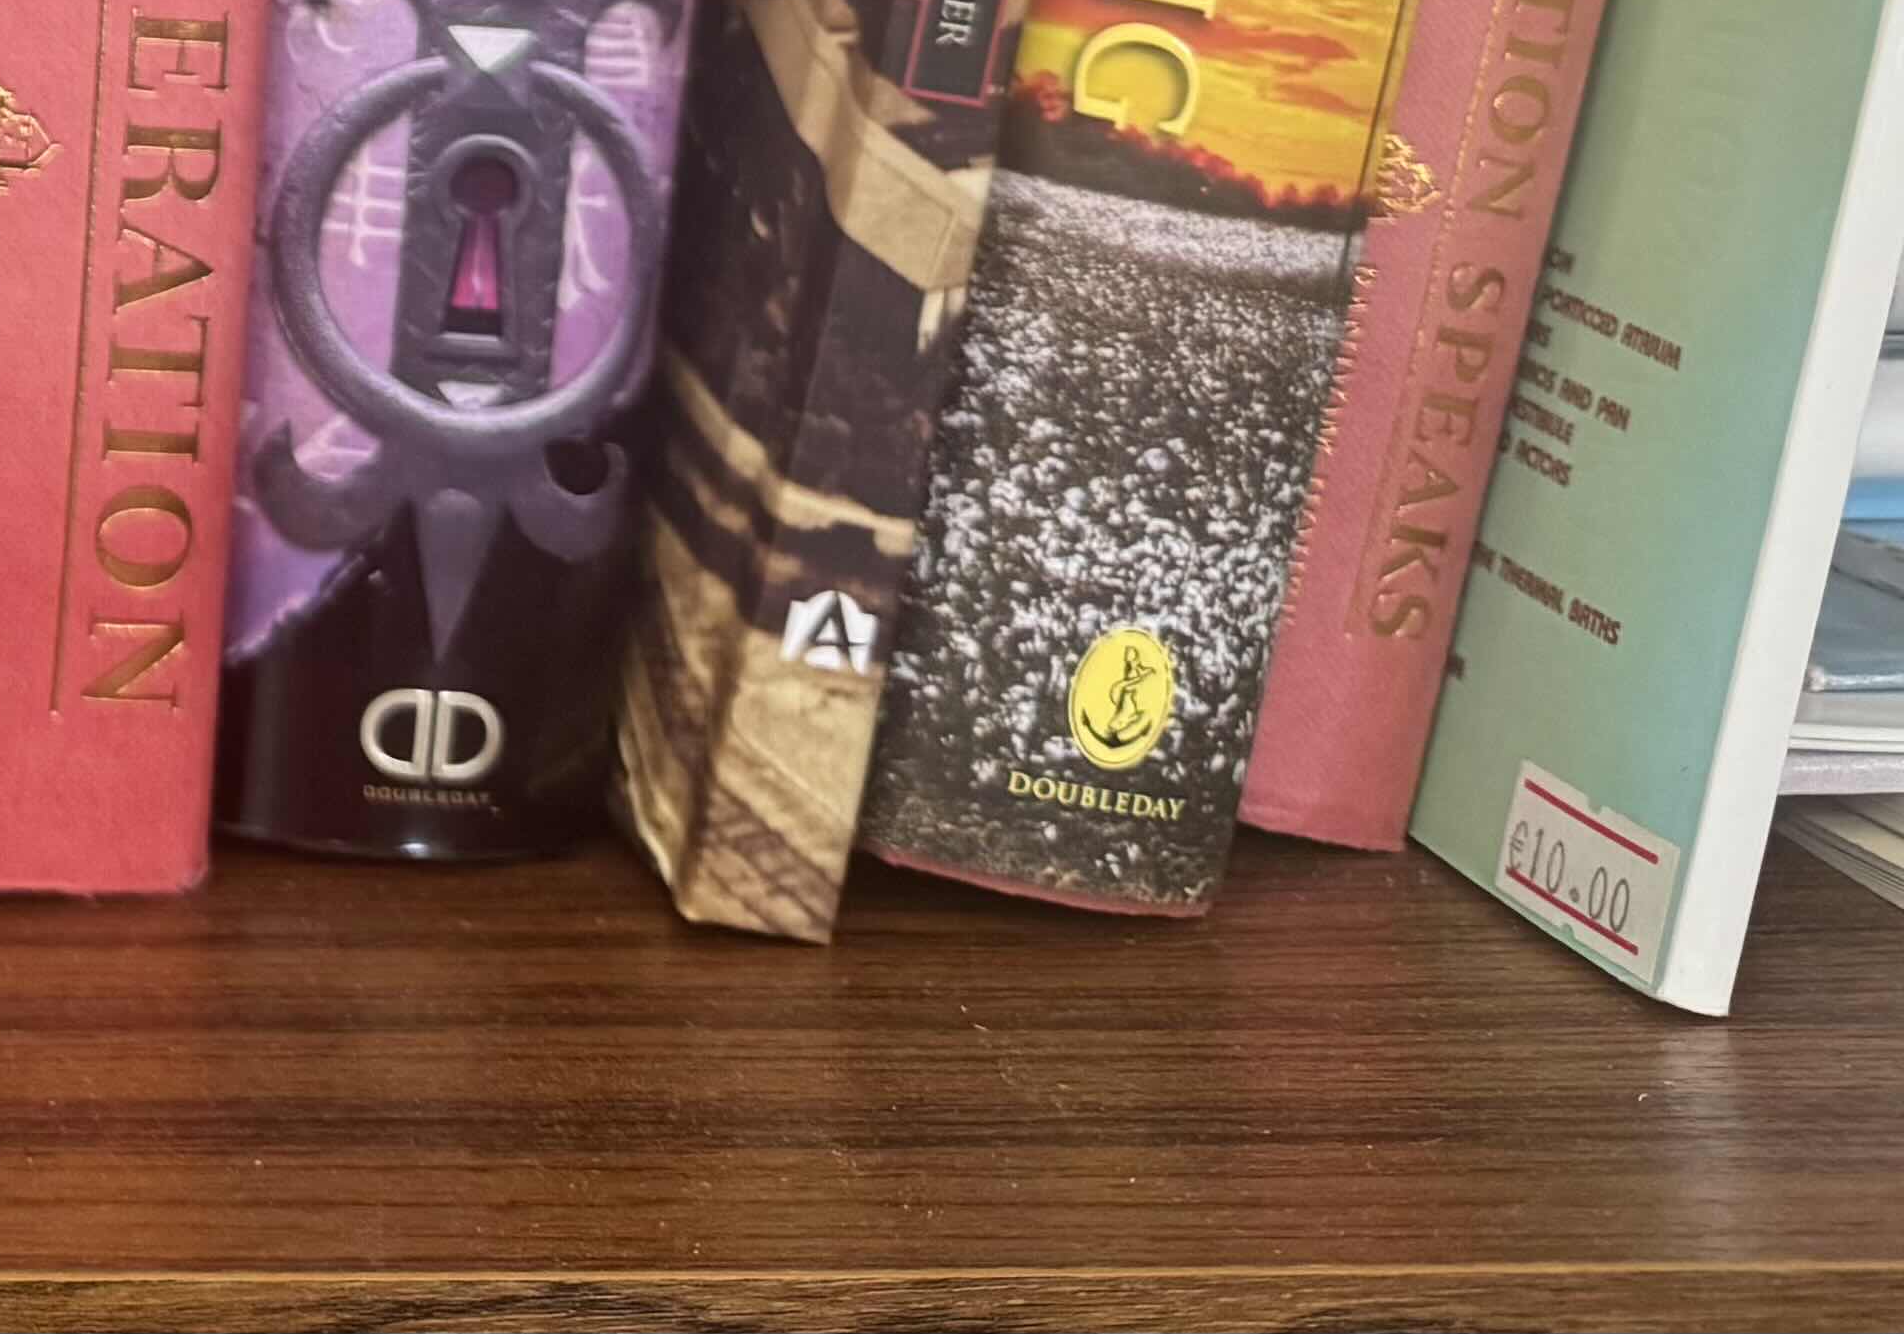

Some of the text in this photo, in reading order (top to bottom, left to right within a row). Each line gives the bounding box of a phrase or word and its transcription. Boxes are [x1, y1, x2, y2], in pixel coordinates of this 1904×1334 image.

[1558, 377, 1593, 411] AND
[1368, 260, 1506, 639] SPEAKS
[1567, 597, 1622, 646] BATHS
[1007, 770, 1186, 823] DOUBLEDAY
